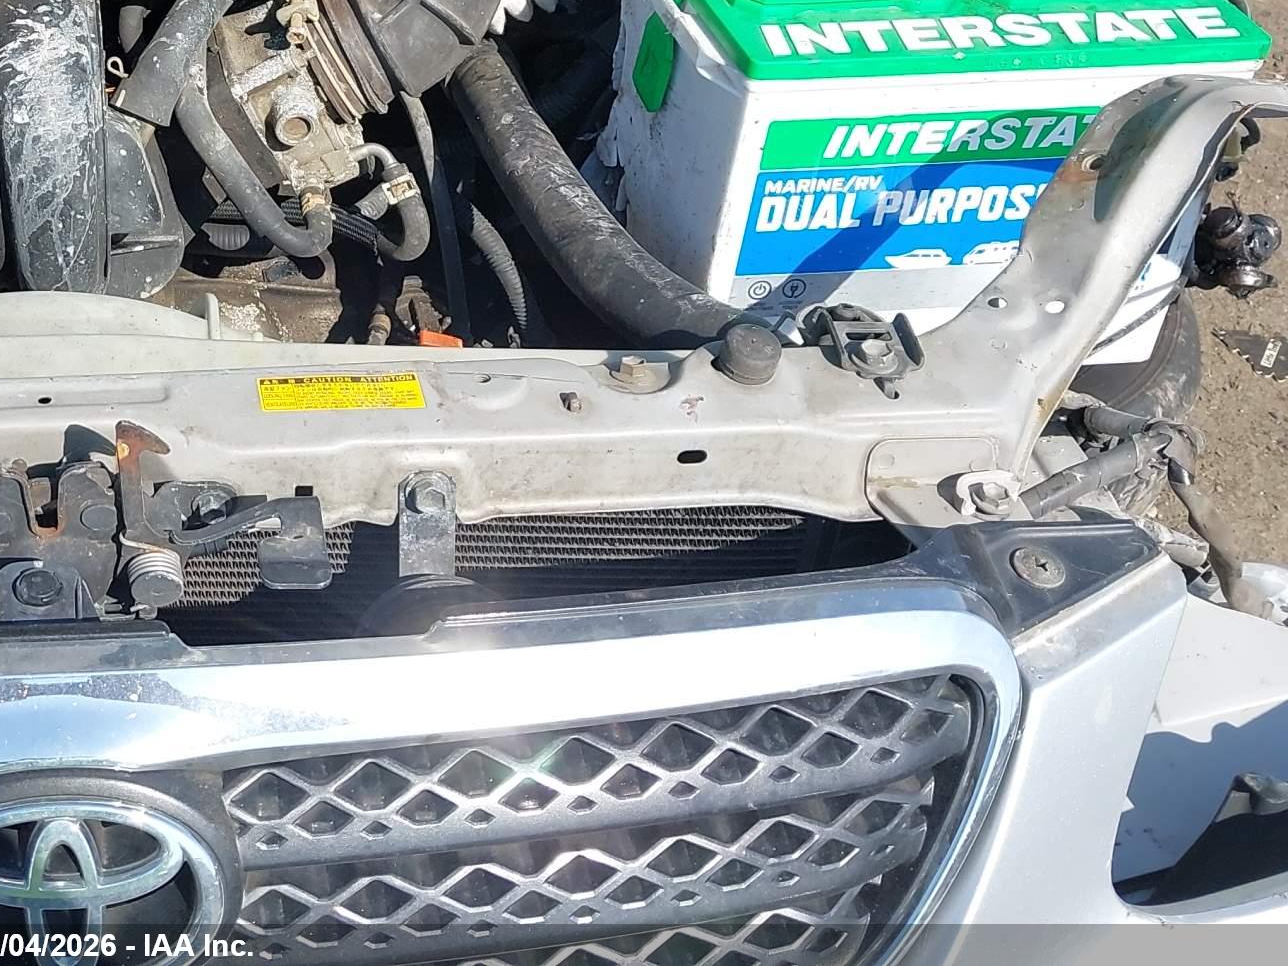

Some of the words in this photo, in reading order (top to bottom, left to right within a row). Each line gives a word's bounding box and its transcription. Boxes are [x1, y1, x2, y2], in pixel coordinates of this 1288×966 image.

[759, 6, 1241, 57] INTERSTATE
[823, 114, 1096, 159] INTERSTA
[764, 175, 884, 194] MARINE/RV
[755, 192, 861, 232] DUAL
[872, 183, 1049, 228] PURPOS
[360, 374, 413, 383] ATTENTION
